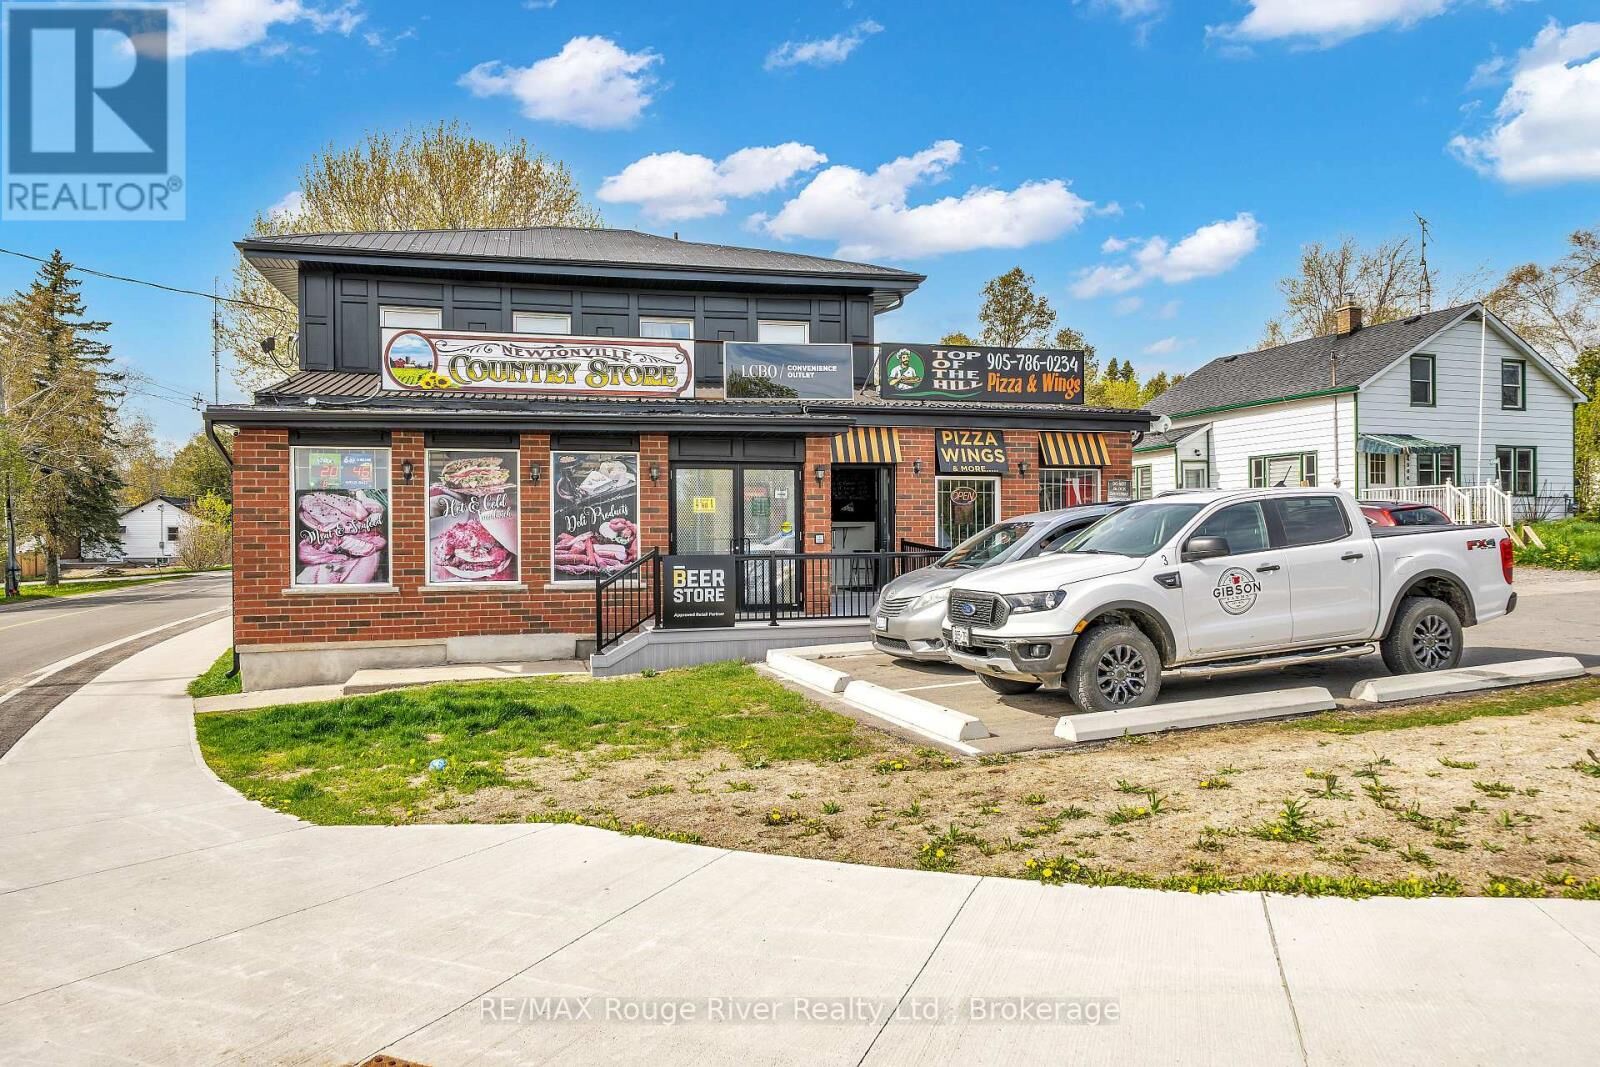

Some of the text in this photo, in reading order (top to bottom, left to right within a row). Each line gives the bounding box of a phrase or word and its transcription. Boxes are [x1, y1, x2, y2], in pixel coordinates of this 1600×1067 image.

[501, 344, 632, 362] NEWTONVILLE
[932, 350, 981, 360] TOP
[787, 364, 838, 372] CONVENIENCE
[932, 359, 965, 369] OF
[986, 352, 1079, 373] 905-786-0234
[448, 354, 679, 388] COUNTRY STORE
[741, 364, 778, 378] LCBO
[787, 371, 815, 379] OUTLET
[931, 369, 980, 380] THE
[933, 379, 984, 391] HILL
[987, 372, 1081, 400] Pizza & Wings
[941, 430, 998, 446] PIZZA
[940, 447, 1006, 463] WINGS
[468, 496, 480, 514] &
[483, 493, 508, 511] Cold
[953, 491, 975, 501] OPEN
[565, 504, 629, 532] Deli Products
[300, 529, 333, 544] Meat
[335, 523, 345, 537] &
[1161, 554, 1169, 566] 3
[673, 568, 726, 588] BEER
[673, 587, 726, 603] STORE
[1212, 581, 1262, 598] GIBSON
